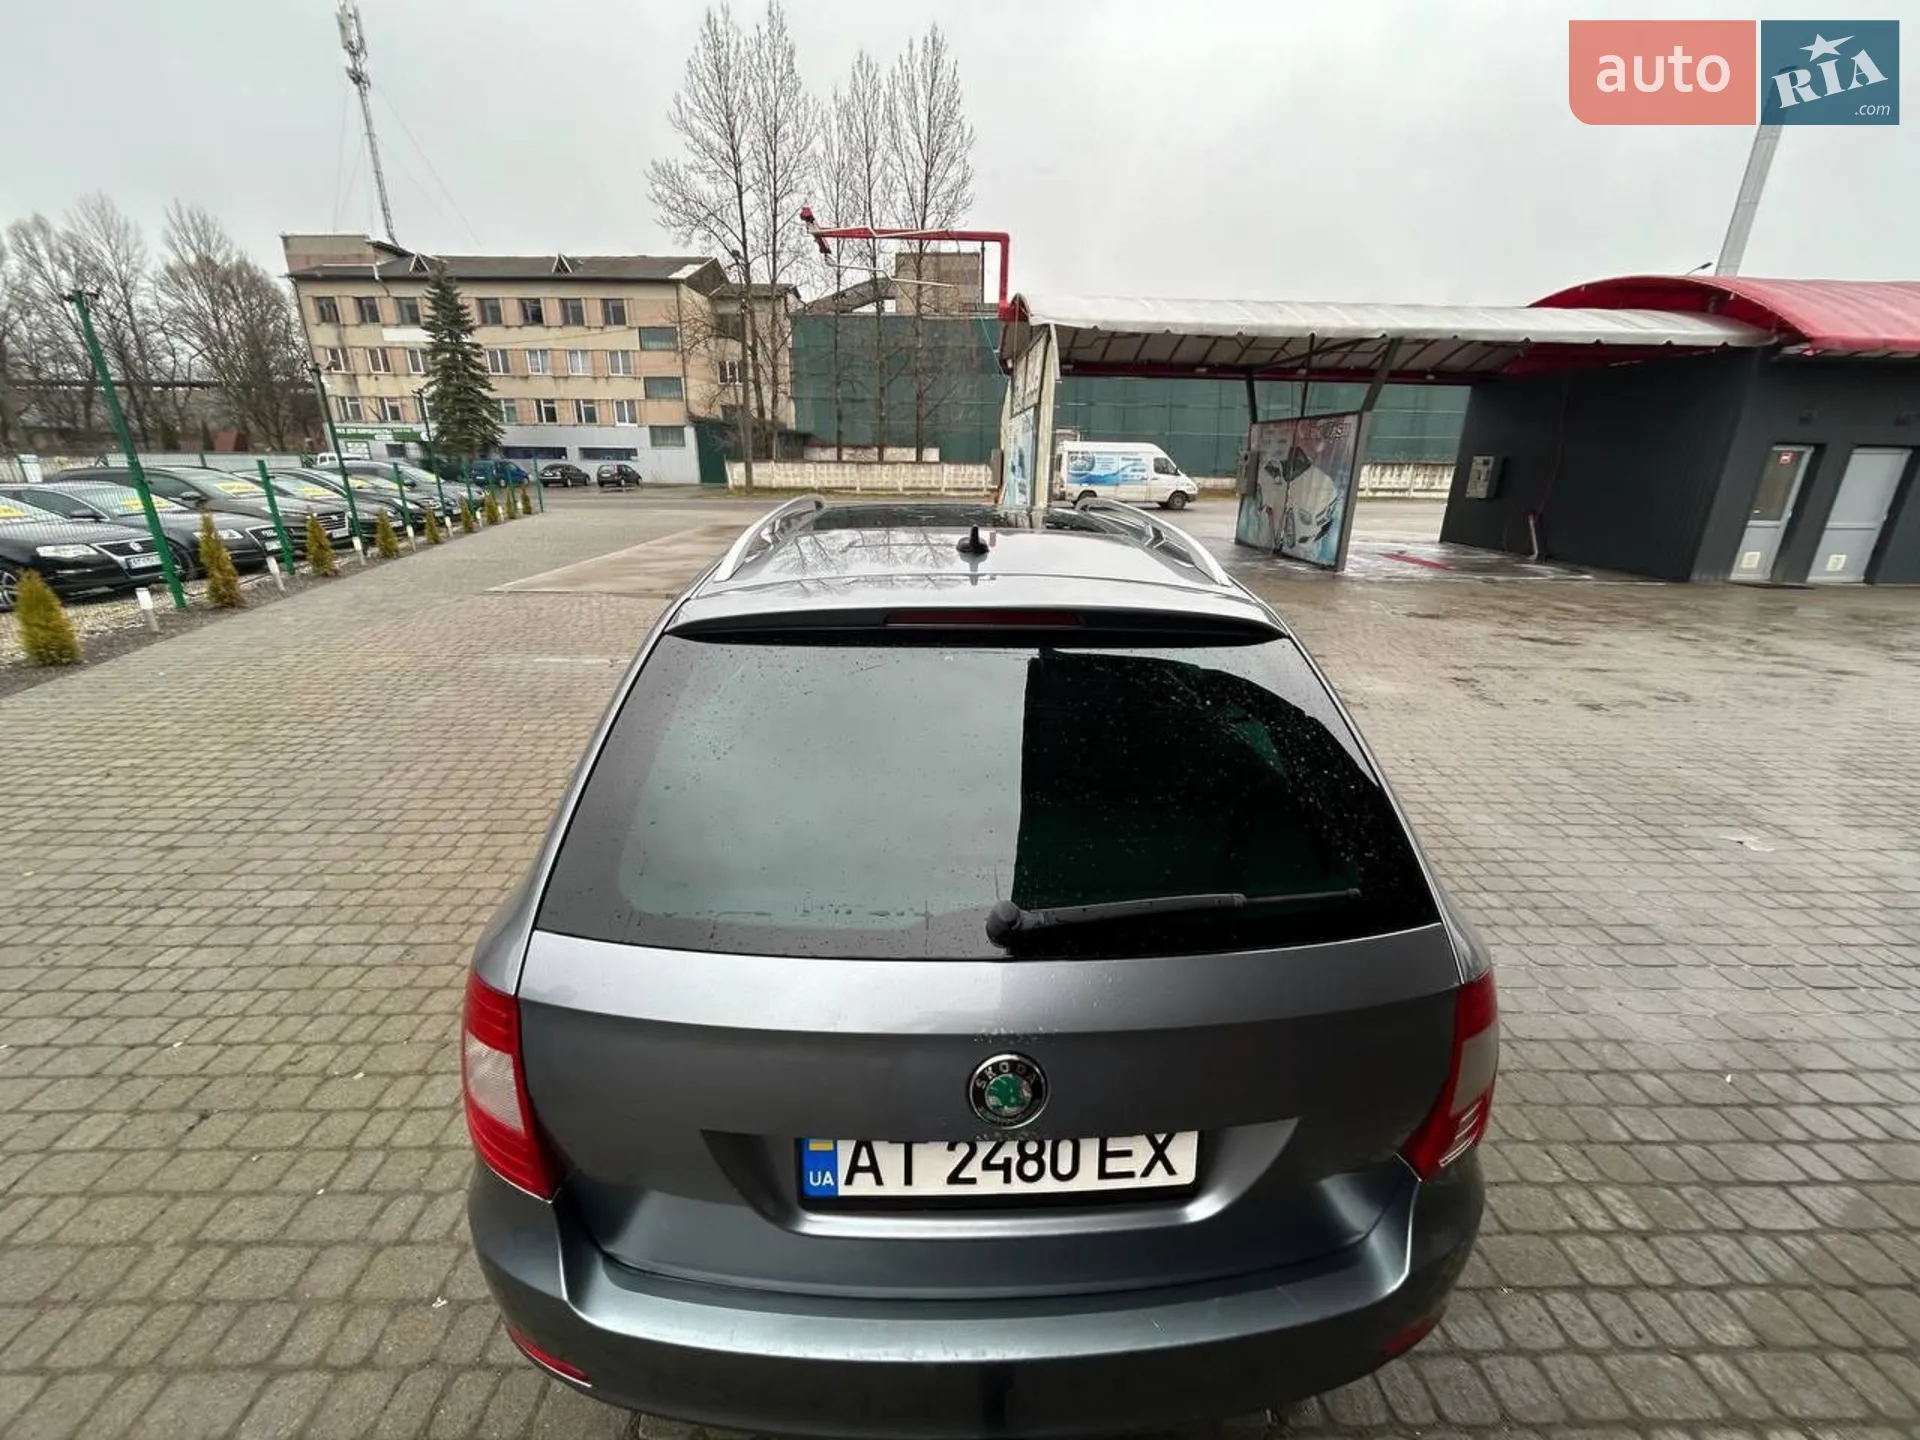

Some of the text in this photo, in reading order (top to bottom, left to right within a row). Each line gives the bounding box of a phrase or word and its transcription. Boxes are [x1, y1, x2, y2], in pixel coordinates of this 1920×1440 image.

[844, 1132, 1178, 1187] AT 2480 EX
[809, 1170, 834, 1187] UA
